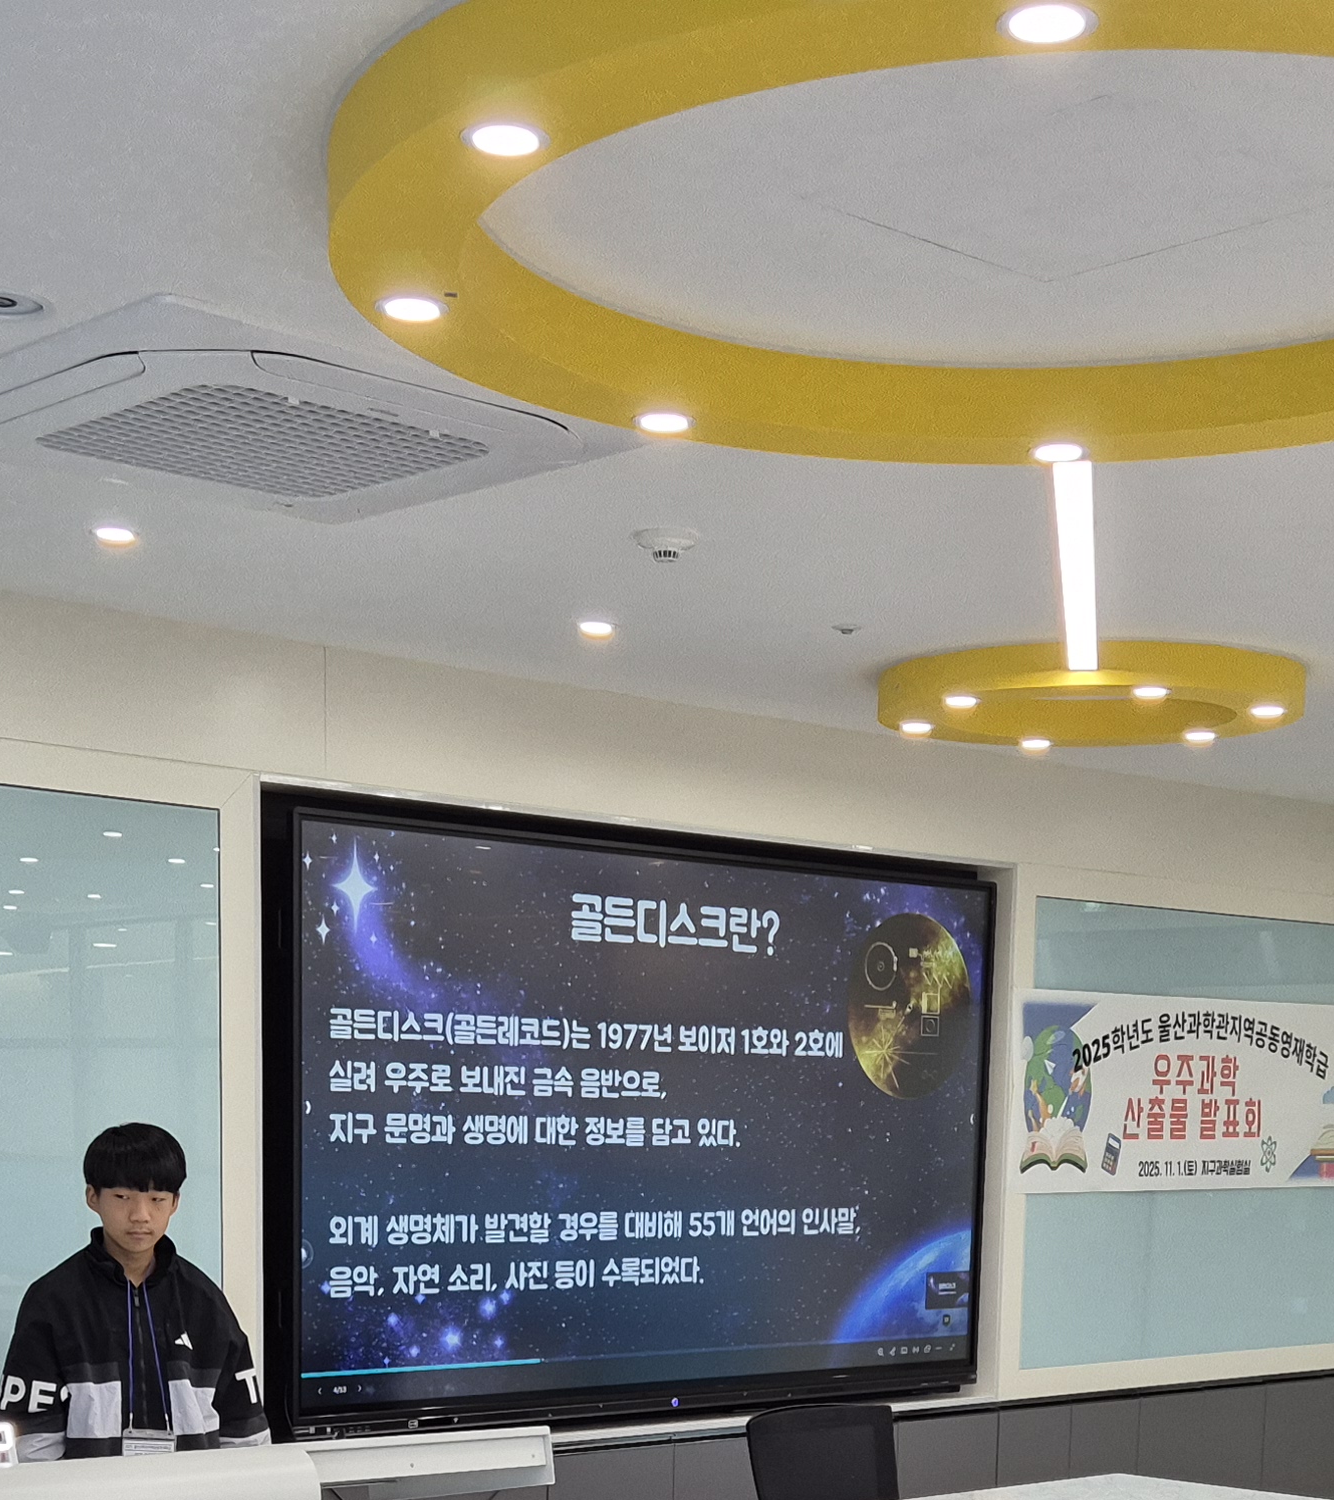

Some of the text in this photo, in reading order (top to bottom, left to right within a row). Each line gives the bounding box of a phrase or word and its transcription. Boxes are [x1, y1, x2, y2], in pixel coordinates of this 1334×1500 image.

[570, 893, 781, 956] 골든디스크란?
[329, 1007, 844, 1059] 골든디스크(골든레코드)는 1977년 보이저 1호와 2호에
[1072, 1018, 1154, 1072] 2025학년도
[329, 1059, 667, 1101] 실려 우주로 보내진 금속 음반으로,
[1152, 1053, 1239, 1097] 우주과학
[329, 1112, 742, 1148] 지구 문명과 생명에 대한 정보를 담고 있다.
[1122, 1097, 1262, 1141] 산출물 발표회
[1138, 1160, 1163, 1177] 2025.
[329, 1206, 862, 1246] 외계 생명체가 발견할 경우를 대비해 55개 언어의 인사말,
[329, 1254, 705, 1298] 음악, 자연 소리, 사진 등이 수록되었다.
